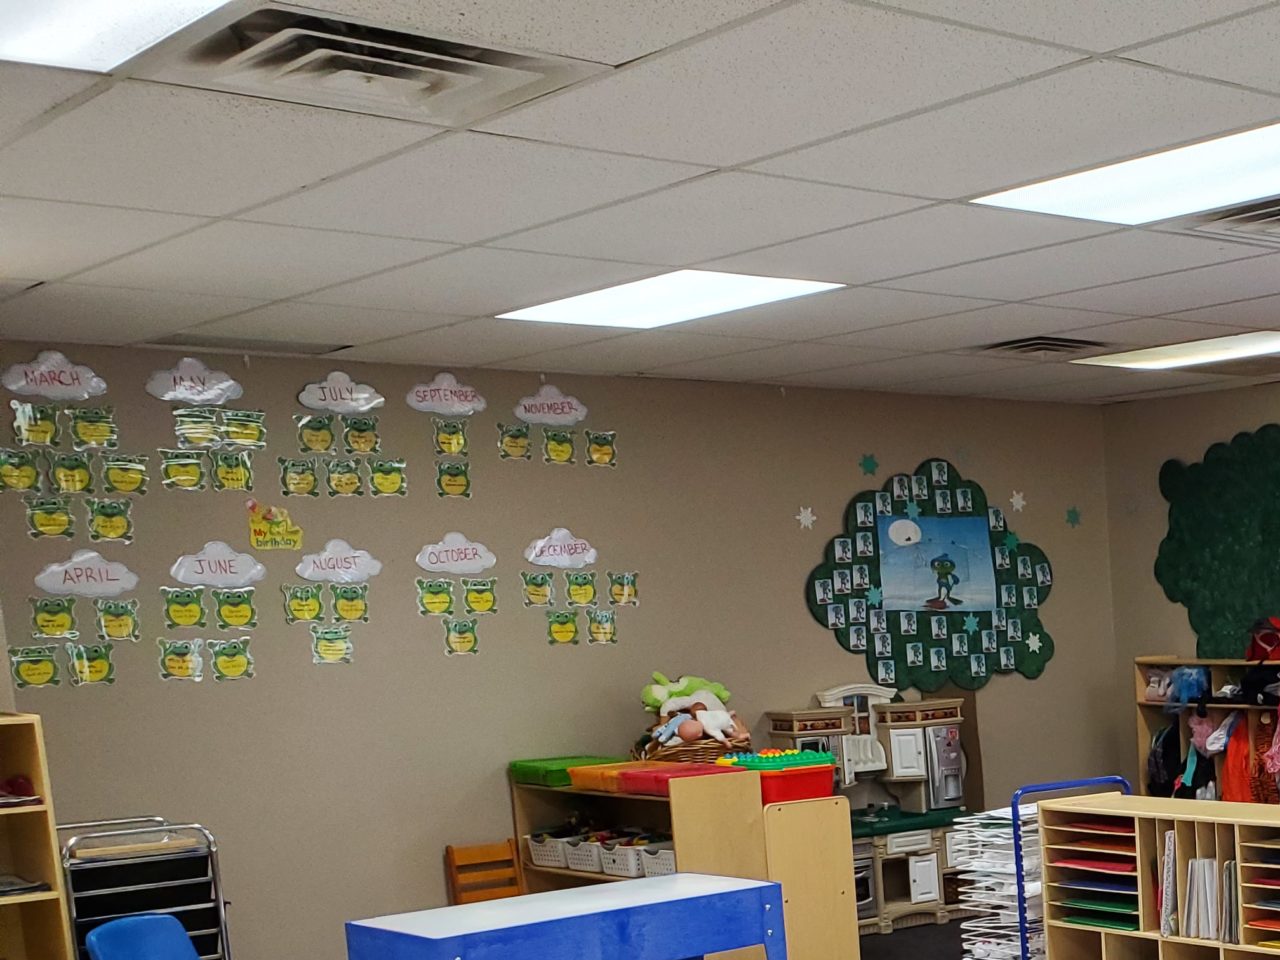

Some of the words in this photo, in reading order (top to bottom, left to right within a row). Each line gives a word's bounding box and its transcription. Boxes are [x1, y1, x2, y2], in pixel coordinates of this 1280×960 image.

[23, 370, 82, 387] MARCH
[172, 374, 207, 392] MAY
[318, 385, 357, 402] JULY
[415, 388, 481, 403] SEPTEMBER
[523, 401, 578, 416] NOVEMBER
[253, 528, 267, 539] My
[256, 537, 298, 548] birthday
[534, 542, 590, 559] DECEMBER
[312, 555, 361, 571] AUGUST
[427, 547, 483, 565] OCTOBER
[193, 559, 238, 575] JUNE
[62, 567, 121, 585] APRIL
